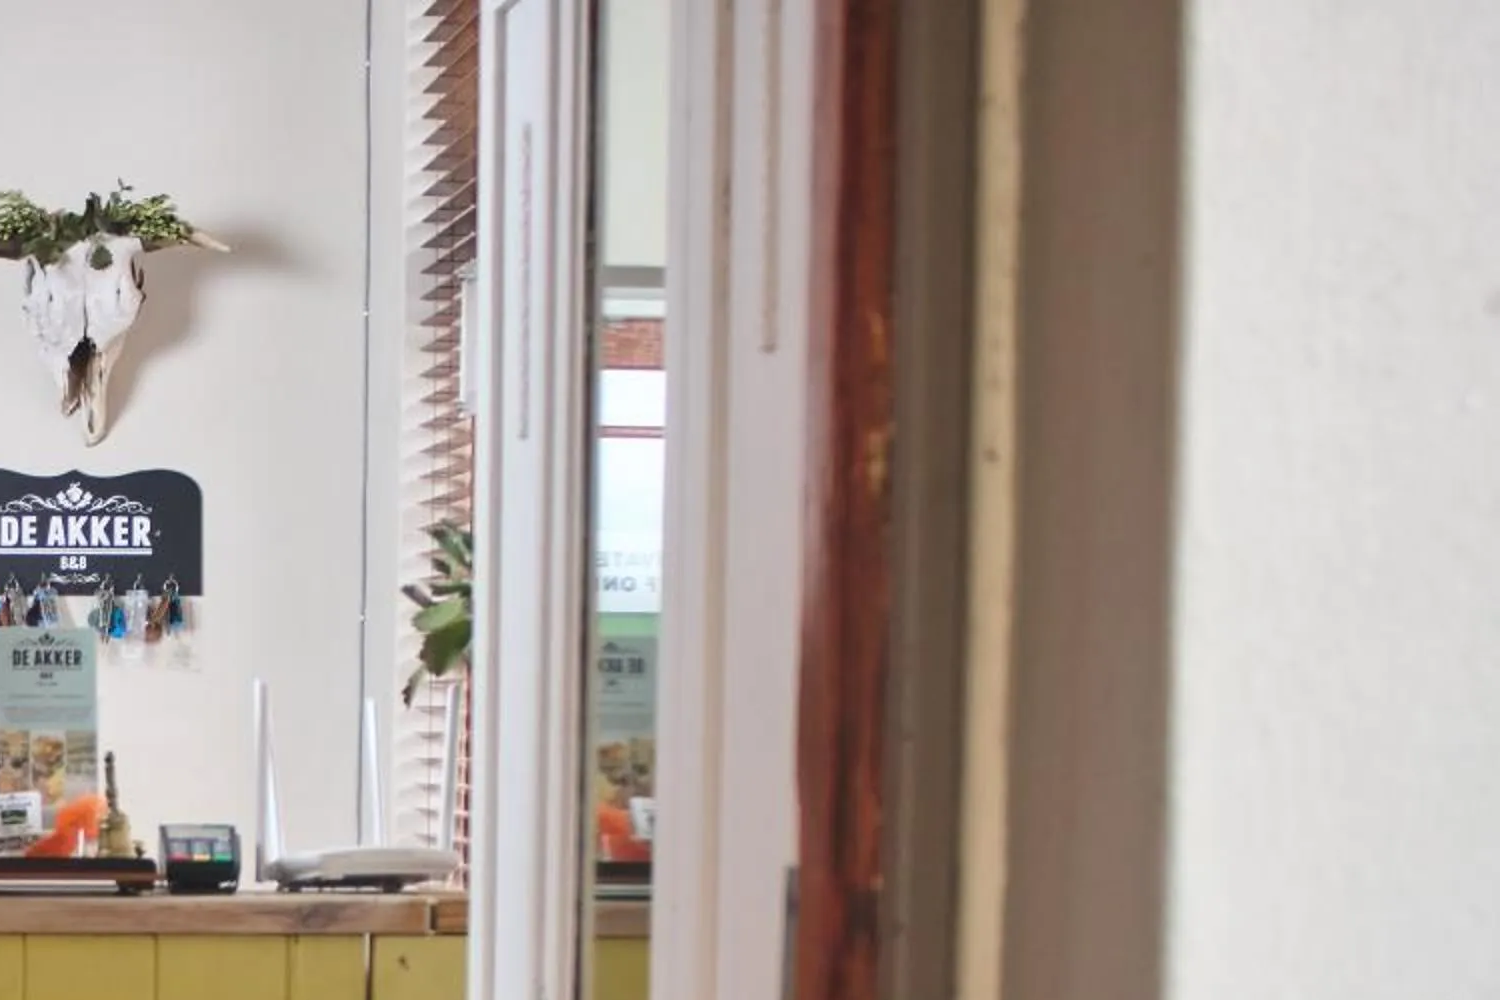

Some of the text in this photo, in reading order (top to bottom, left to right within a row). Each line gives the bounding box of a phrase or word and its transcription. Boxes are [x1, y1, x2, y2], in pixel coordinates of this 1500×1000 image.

[0, 515, 152, 547] DE AKKER
[59, 555, 88, 570] B&B
[12, 649, 83, 666] DE AKKER
